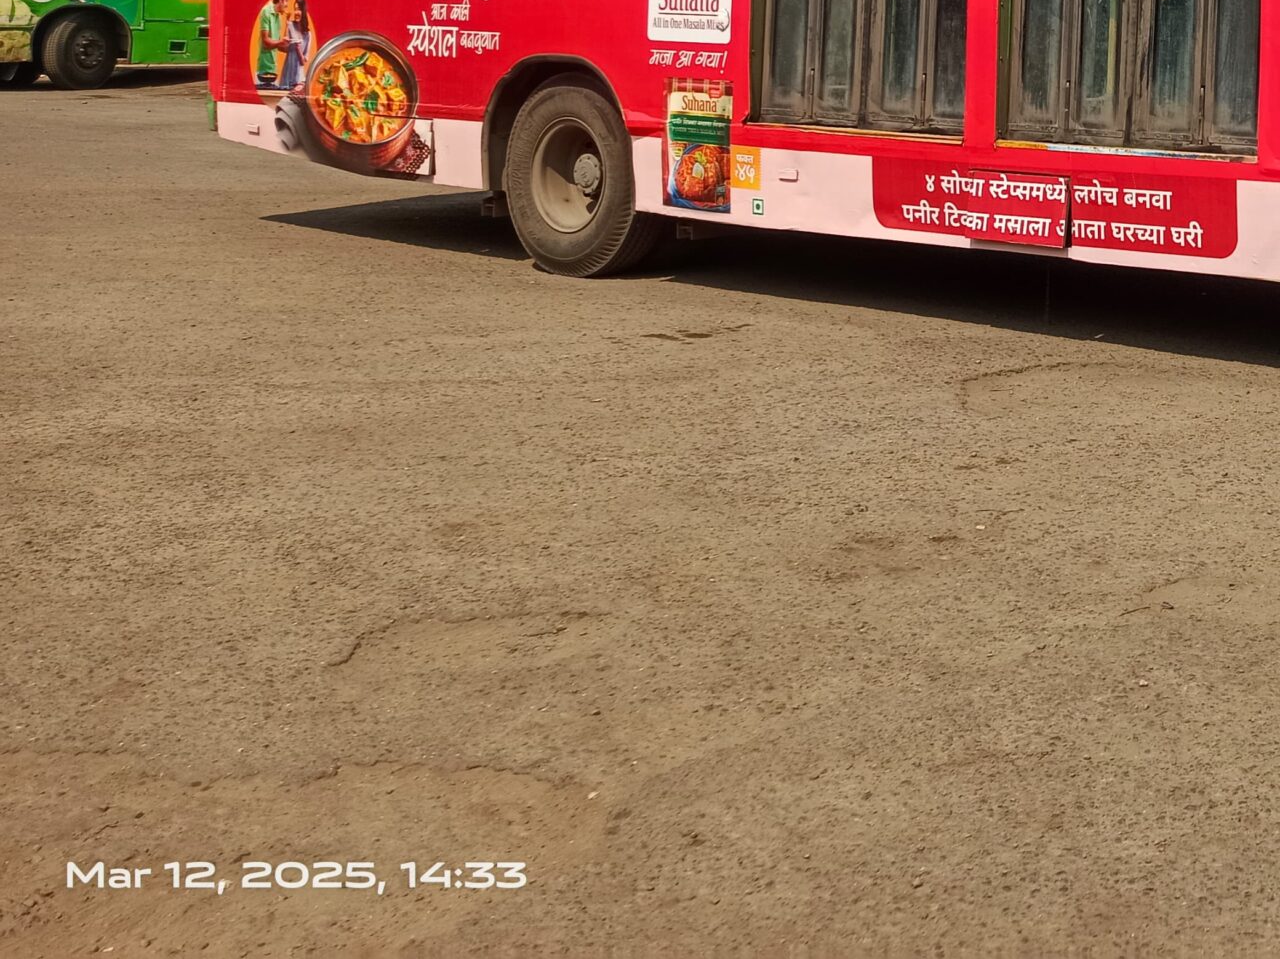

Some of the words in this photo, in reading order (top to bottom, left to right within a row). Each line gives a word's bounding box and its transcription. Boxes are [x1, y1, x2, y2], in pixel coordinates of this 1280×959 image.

[406, 11, 460, 59] स्पेशल
[649, 49, 677, 67] मज़ा
[676, 50, 696, 69] आ
[695, 50, 728, 75] गया!
[681, 94, 717, 113] Suhana
[924, 173, 936, 193] ४
[988, 173, 1068, 204] स्टेप्समध्ये
[1073, 178, 1119, 207] लगेच
[1123, 187, 1173, 211] बनवा
[901, 199, 940, 226] पनीर
[993, 214, 1052, 238] मसाला
[1110, 221, 1166, 246] घरच्या
[1170, 220, 1204, 249] घरी
